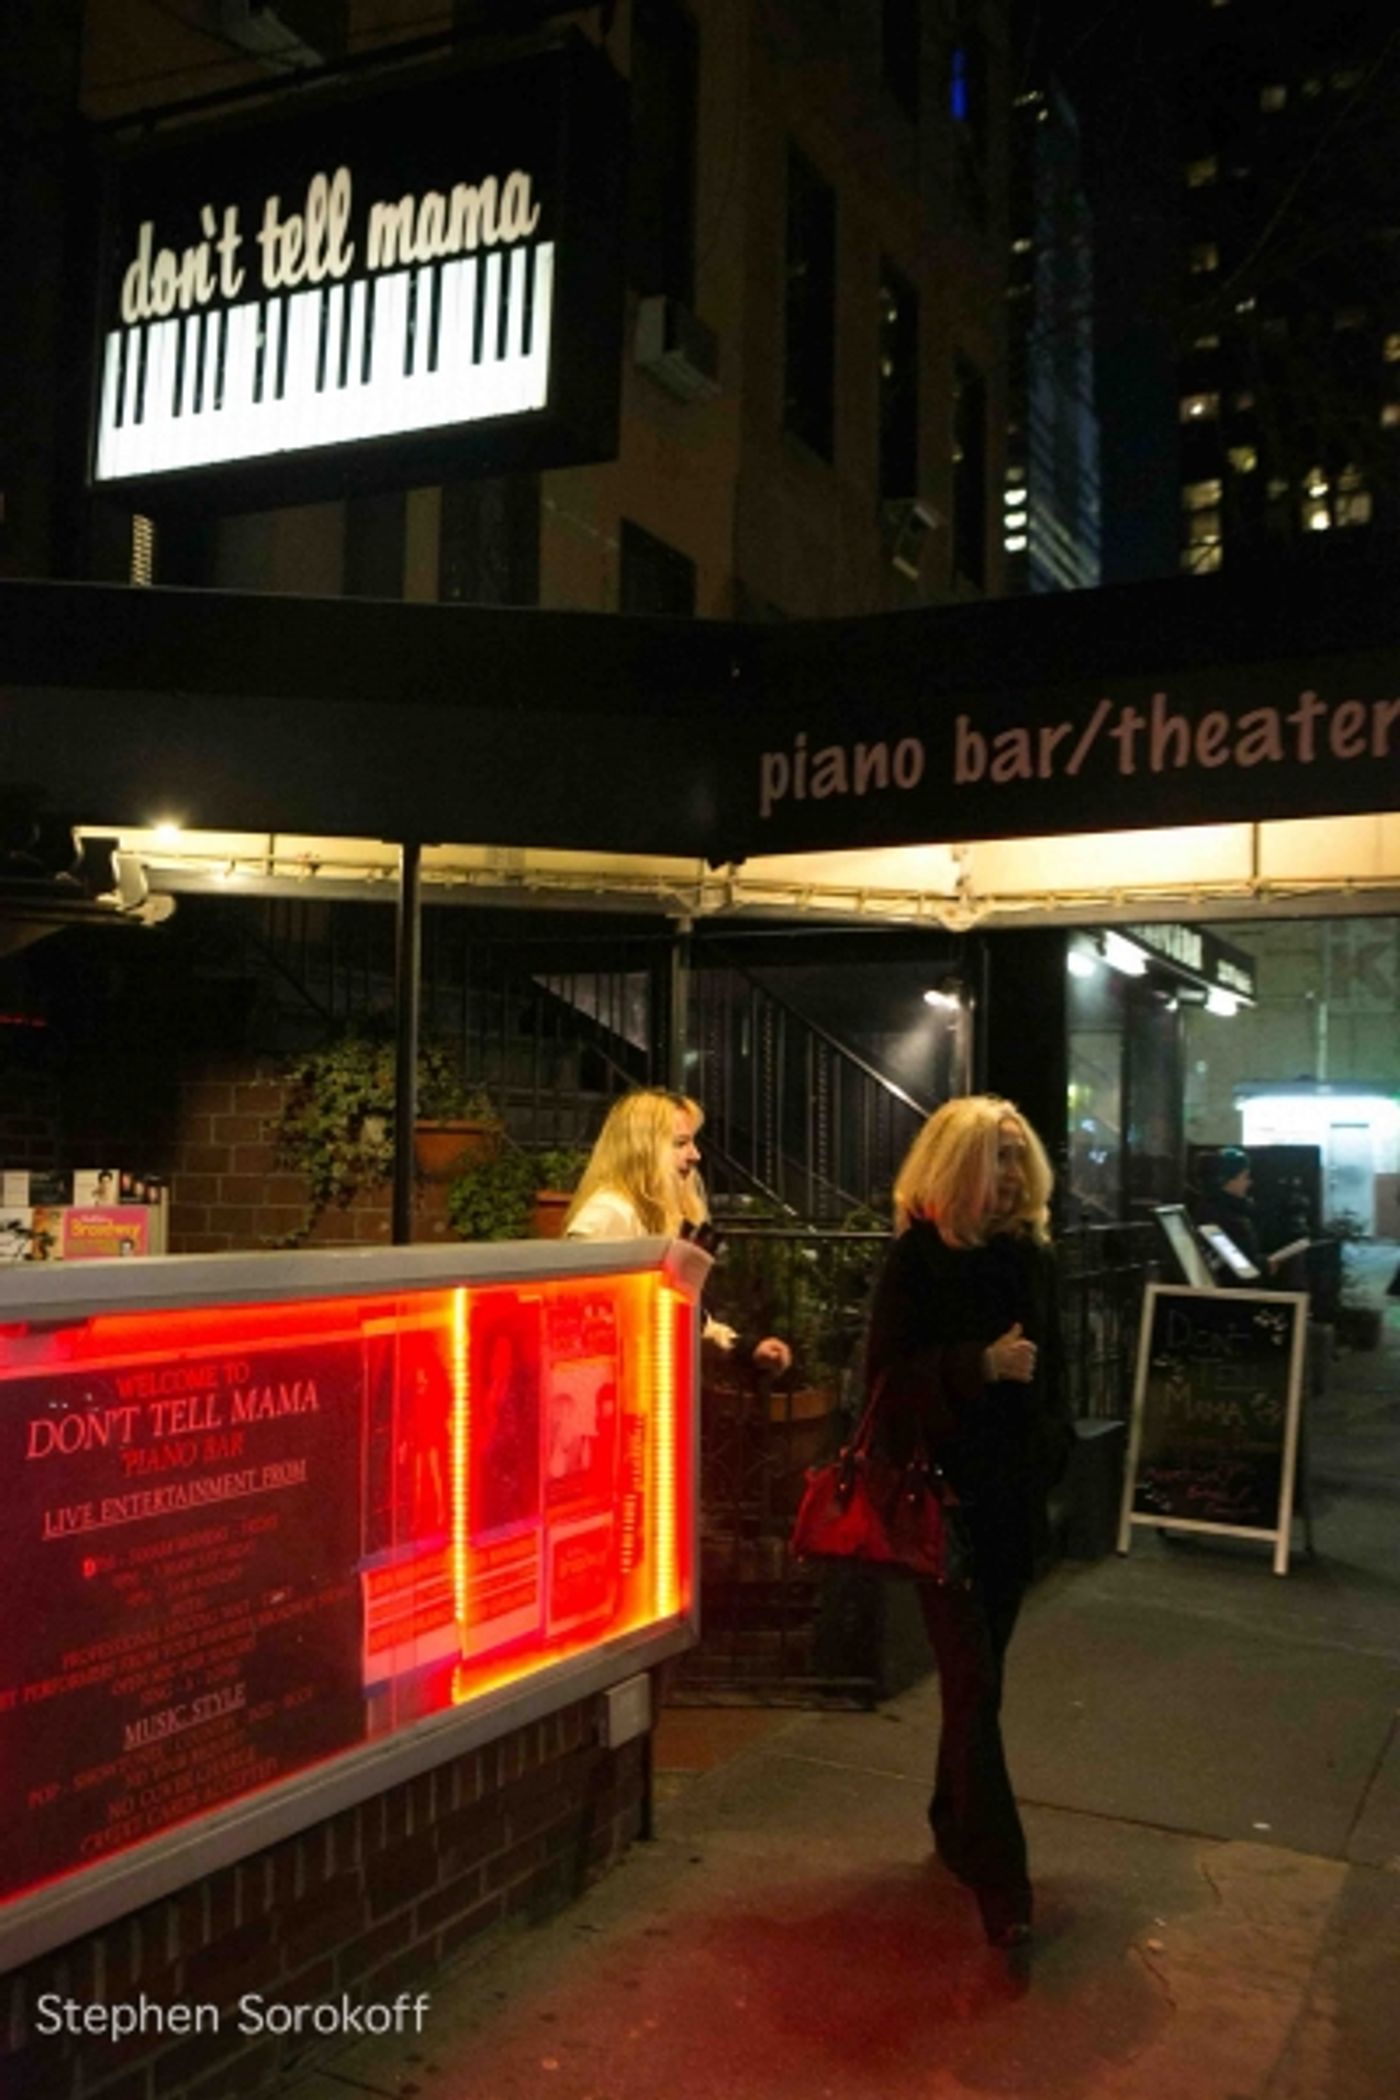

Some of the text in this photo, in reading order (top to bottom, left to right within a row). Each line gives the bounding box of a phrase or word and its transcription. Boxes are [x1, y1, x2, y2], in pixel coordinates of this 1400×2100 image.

[122, 166, 541, 323] don't tell mama
[758, 733, 925, 819] piano
[26, 1378, 320, 1460] DON'T TELL MAMA
[116, 1361, 250, 1399] WELCOME TO
[121, 1439, 197, 1478] PIANO
[42, 1459, 307, 1541] LIVE ENTERTAINMENT FROM
[123, 1704, 187, 1750] MUSIC
[192, 1682, 247, 1724] STYLE
